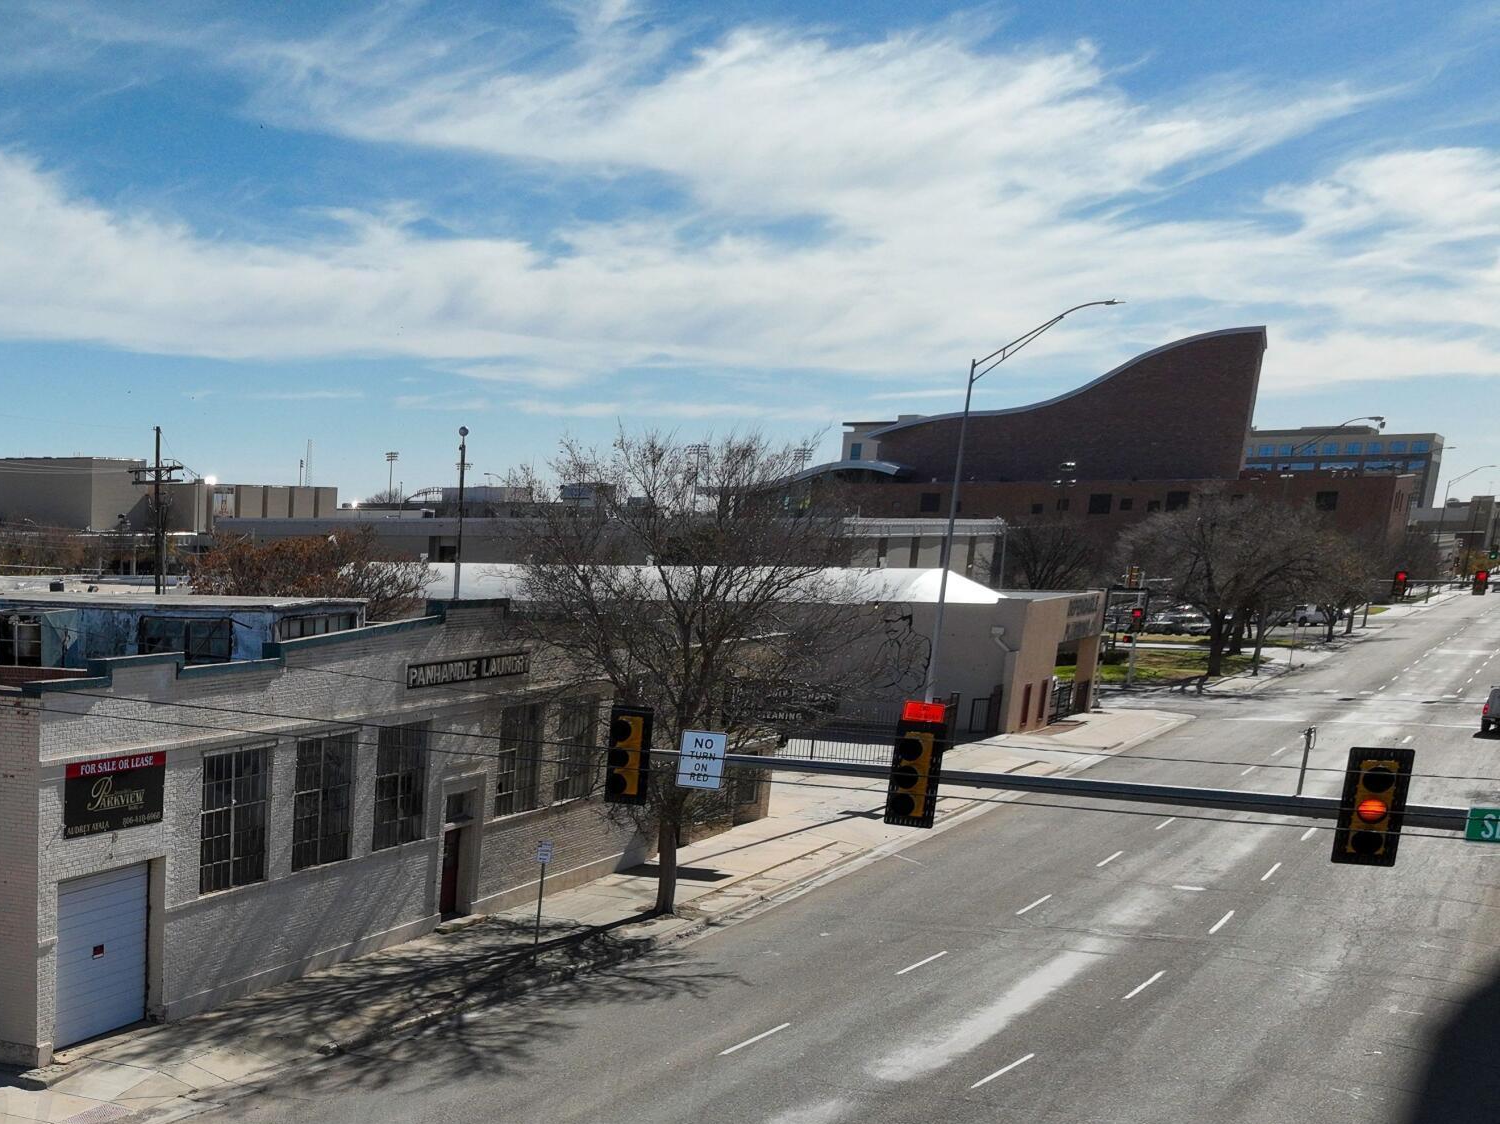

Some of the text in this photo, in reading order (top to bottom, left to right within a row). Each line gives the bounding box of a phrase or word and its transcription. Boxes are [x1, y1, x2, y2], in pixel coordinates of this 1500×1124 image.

[409, 660, 477, 687] PANHANDLE
[694, 738, 714, 749] NO
[690, 750, 716, 761] TURN
[80, 755, 154, 775] FOR SALE OR LEASE
[694, 763, 708, 772] ON
[689, 773, 709, 782] RED
[87, 775, 146, 811] PARKVIEW
